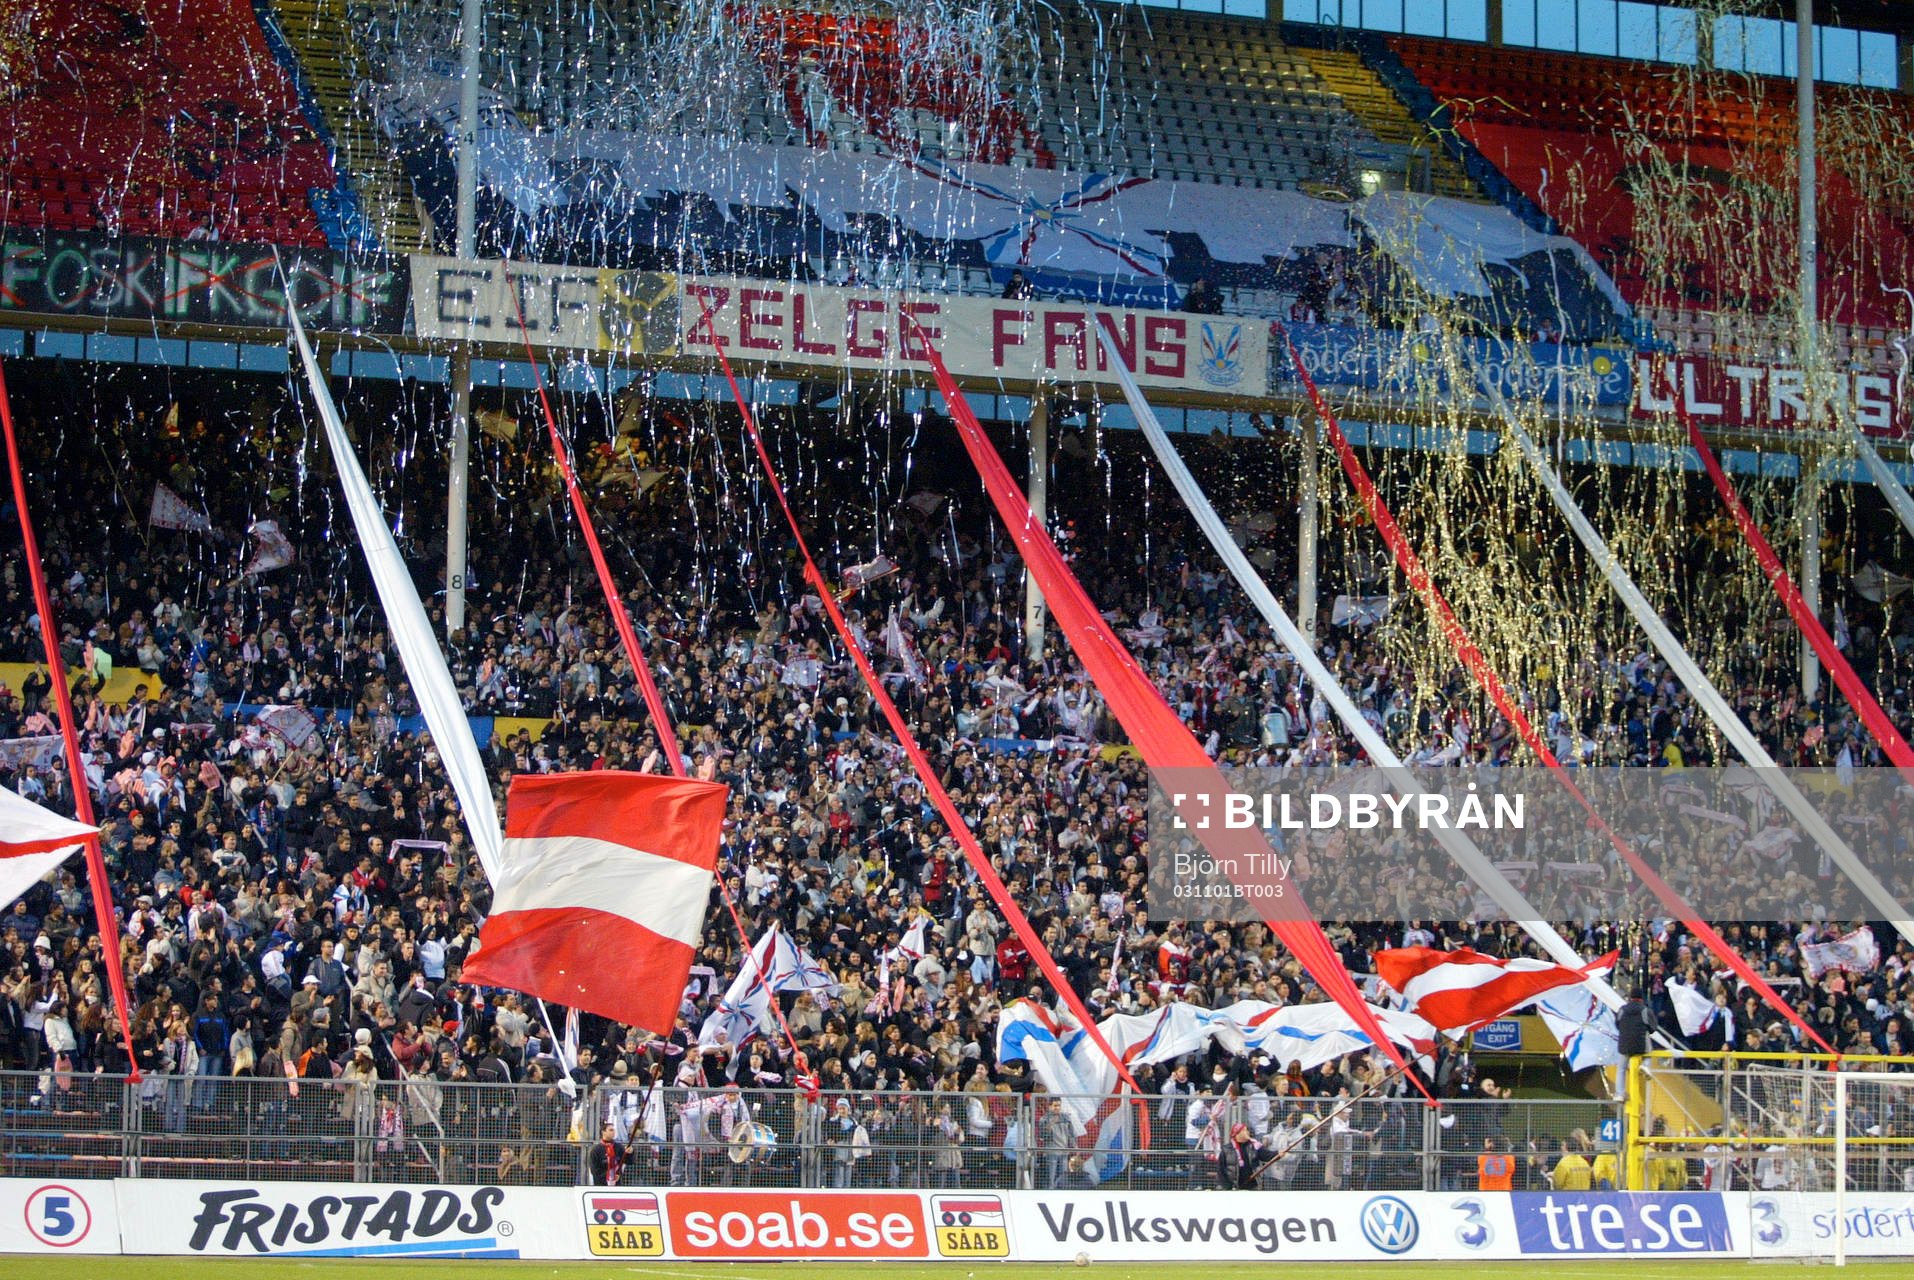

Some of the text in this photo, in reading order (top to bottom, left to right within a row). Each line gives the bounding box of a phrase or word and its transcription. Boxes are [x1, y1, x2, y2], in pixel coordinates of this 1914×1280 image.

[438, 269, 598, 333] EIF
[686, 284, 1187, 378] ZELGE FANS
[452, 575, 462, 589] 8
[1033, 605, 1042, 619] 7
[1488, 1034, 1508, 1043] EXIT
[1602, 1120, 1620, 1140] 41
[43, 1197, 75, 1236] 5
[189, 1186, 505, 1252] FRISTADS
[685, 1201, 915, 1249] soab.se
[1037, 1201, 1337, 1254] Volkswagen
[1450, 1197, 1496, 1250] 3
[1540, 1195, 1705, 1252] tre.se
